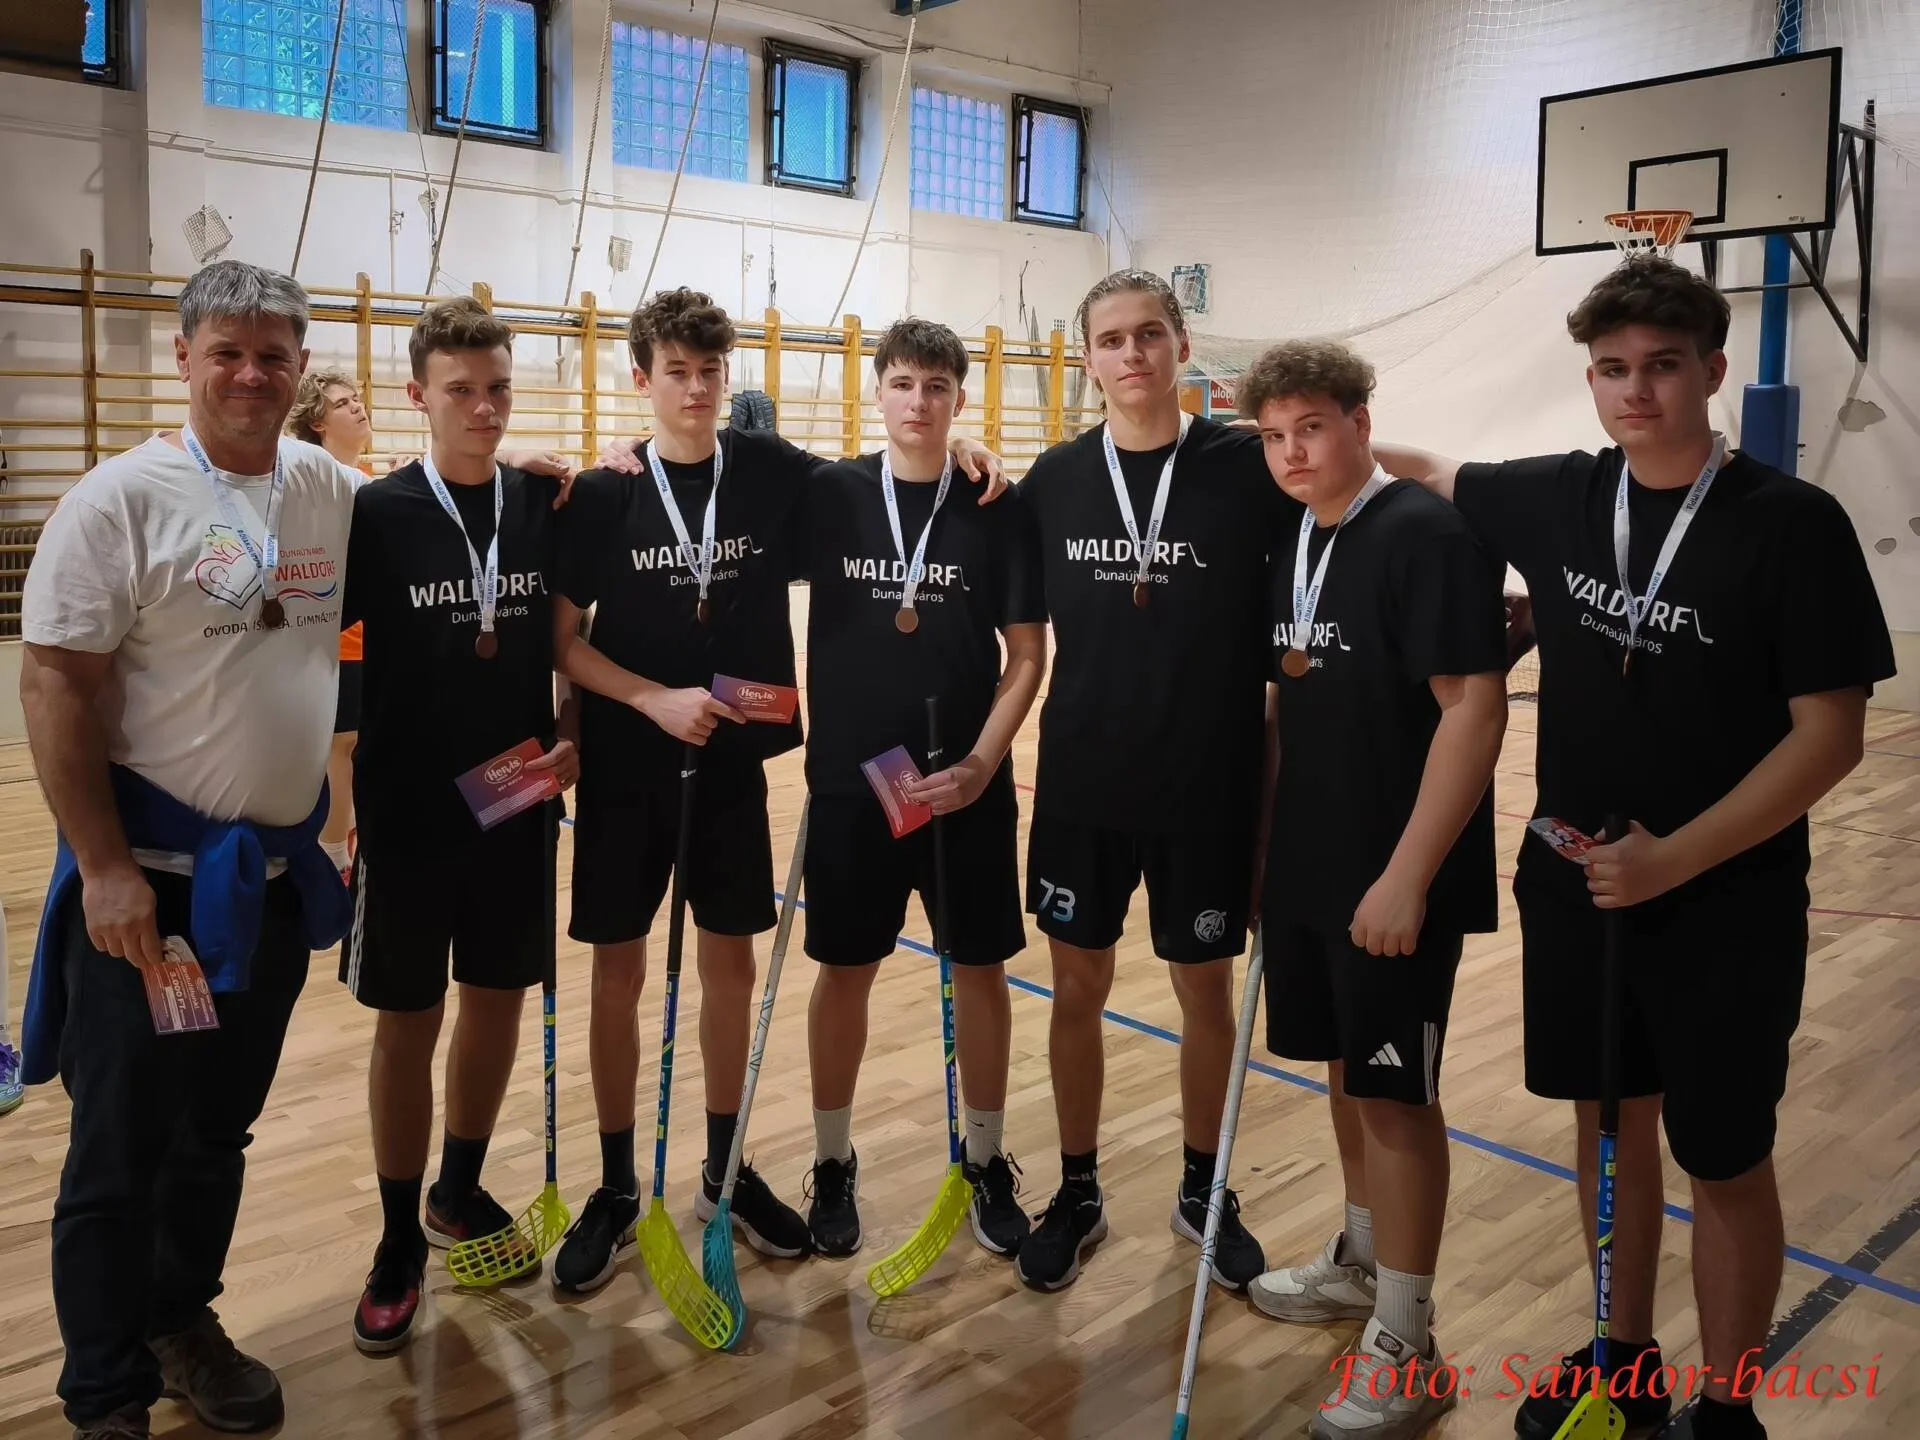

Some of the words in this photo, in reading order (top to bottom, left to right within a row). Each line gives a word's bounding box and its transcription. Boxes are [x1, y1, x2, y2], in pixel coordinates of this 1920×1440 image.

[670, 568, 740, 586] Dunaváros
[410, 571, 538, 609] WALORF
[872, 587, 944, 603] Dunaváros
[452, 605, 529, 624] Dunaváros
[203, 621, 249, 638] ÓVODA
[1039, 877, 1076, 922] 73
